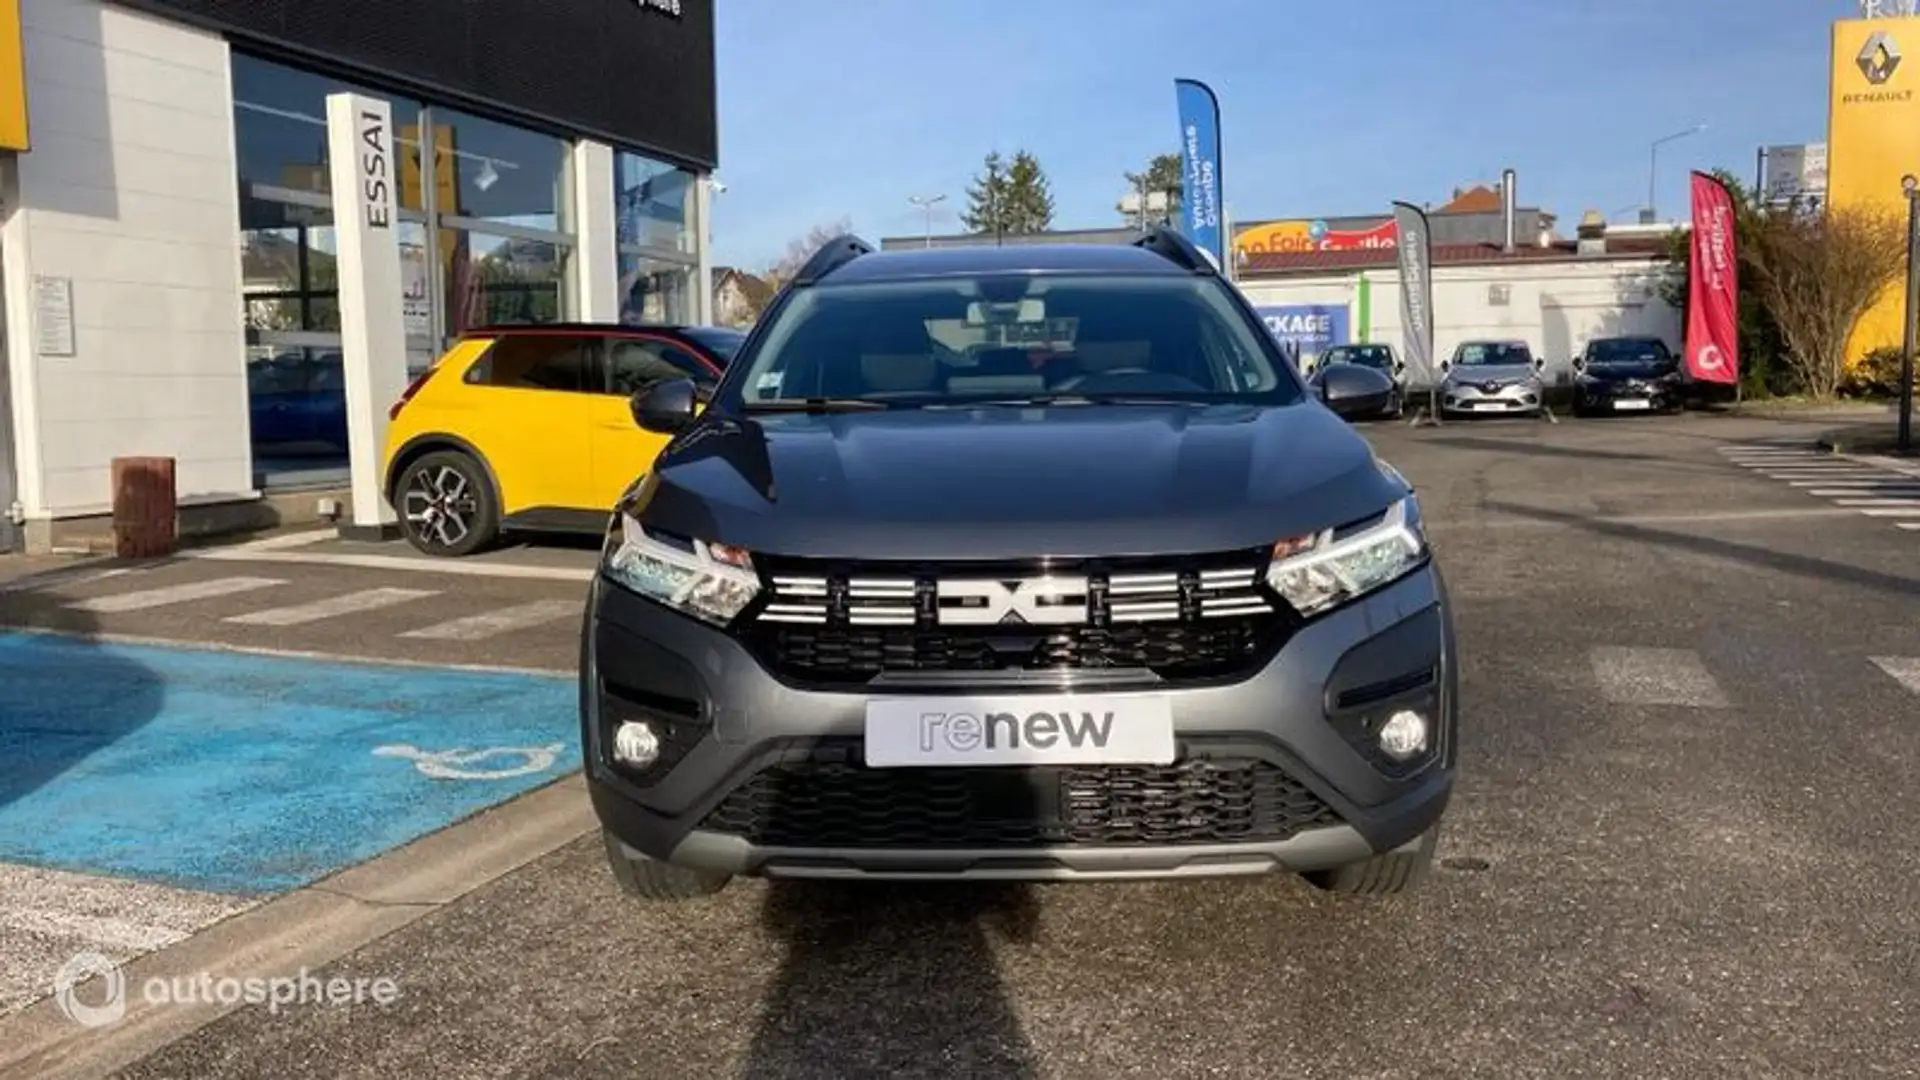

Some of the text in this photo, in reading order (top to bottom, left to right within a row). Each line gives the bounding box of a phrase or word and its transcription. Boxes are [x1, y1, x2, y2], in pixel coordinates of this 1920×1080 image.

[1842, 91, 1913, 104] RENAULT
[361, 111, 389, 229] ESSAI
[919, 711, 1114, 751] renew
